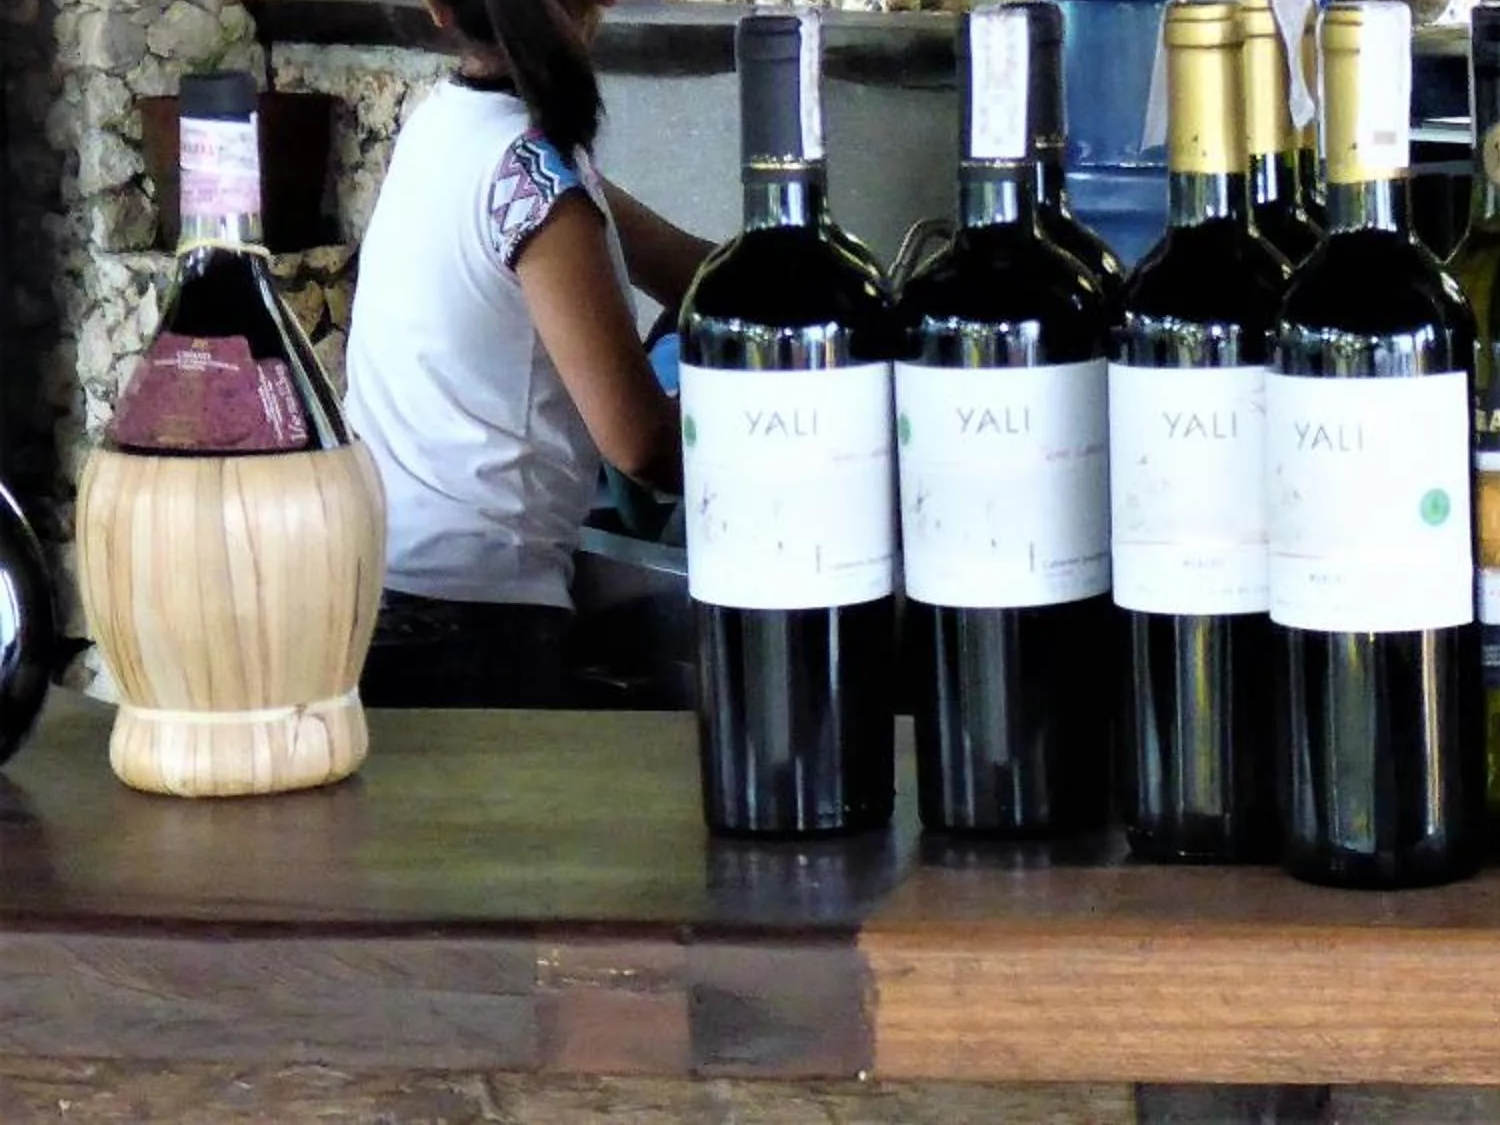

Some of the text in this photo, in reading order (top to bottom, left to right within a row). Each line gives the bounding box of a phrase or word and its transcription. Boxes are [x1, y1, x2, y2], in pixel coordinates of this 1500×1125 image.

[744, 408, 818, 437] YALI
[956, 405, 1030, 434] YALI
[1162, 410, 1238, 439] YALI
[1294, 421, 1364, 452] YALI
